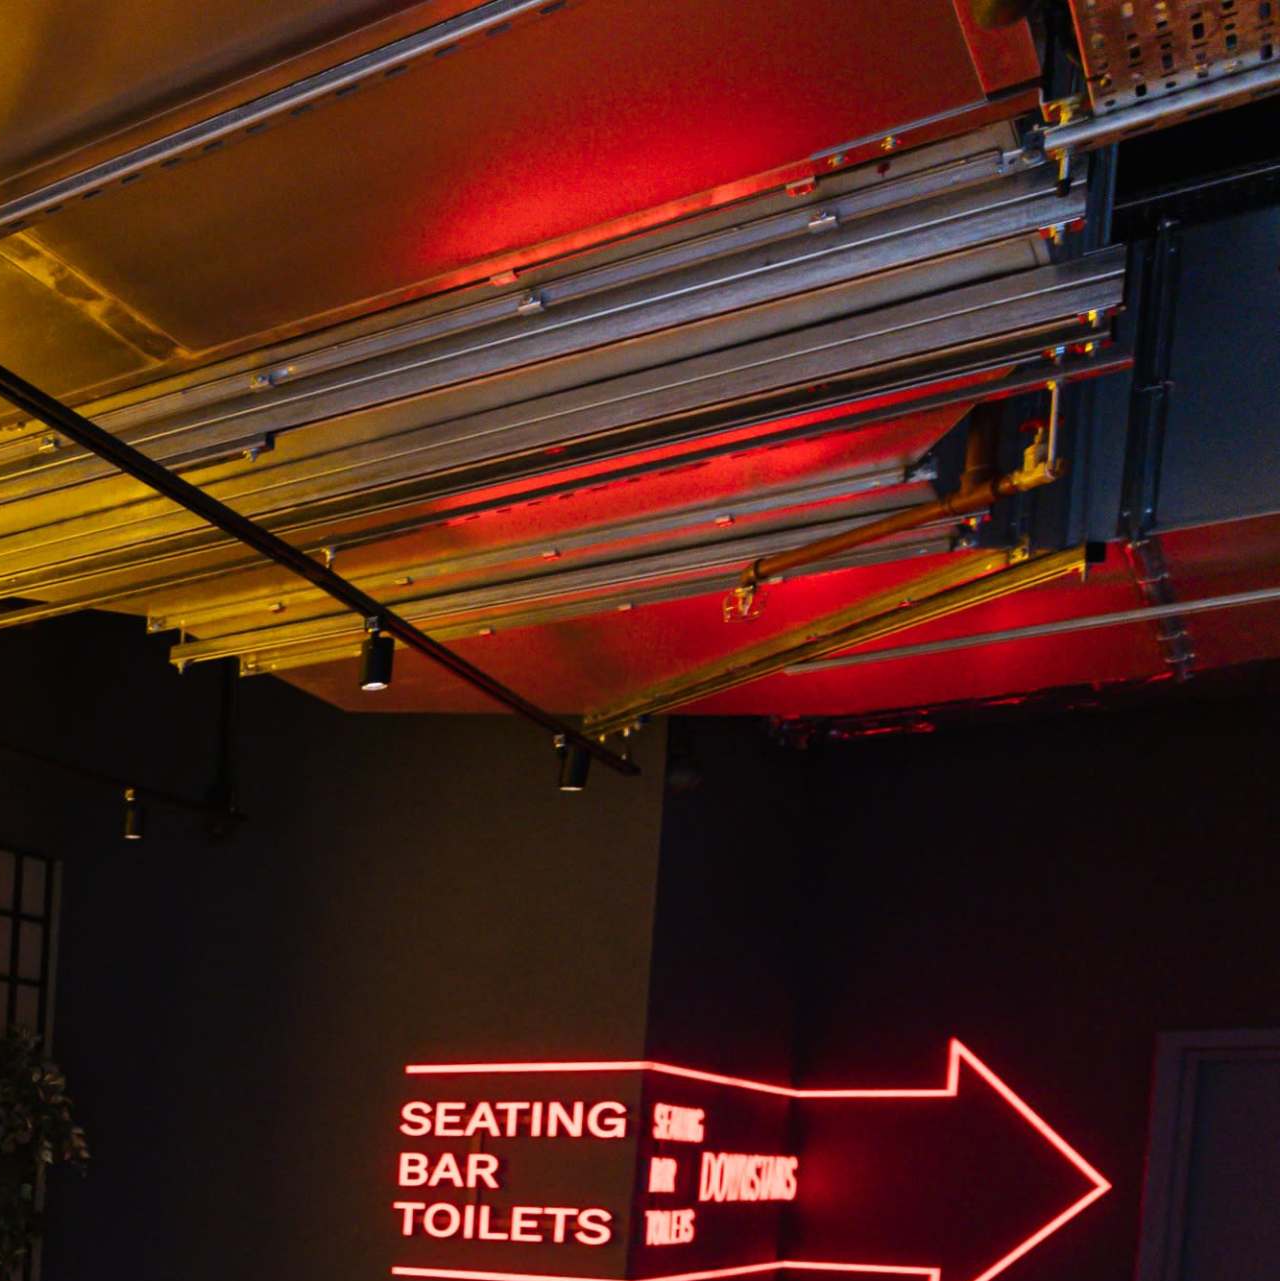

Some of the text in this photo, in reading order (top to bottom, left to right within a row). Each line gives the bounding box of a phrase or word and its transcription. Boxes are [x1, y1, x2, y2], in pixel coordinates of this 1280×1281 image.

[400, 1101, 628, 1139] SEATING
[397, 1152, 500, 1190] BAR
[393, 1200, 613, 1246] TOILETS
